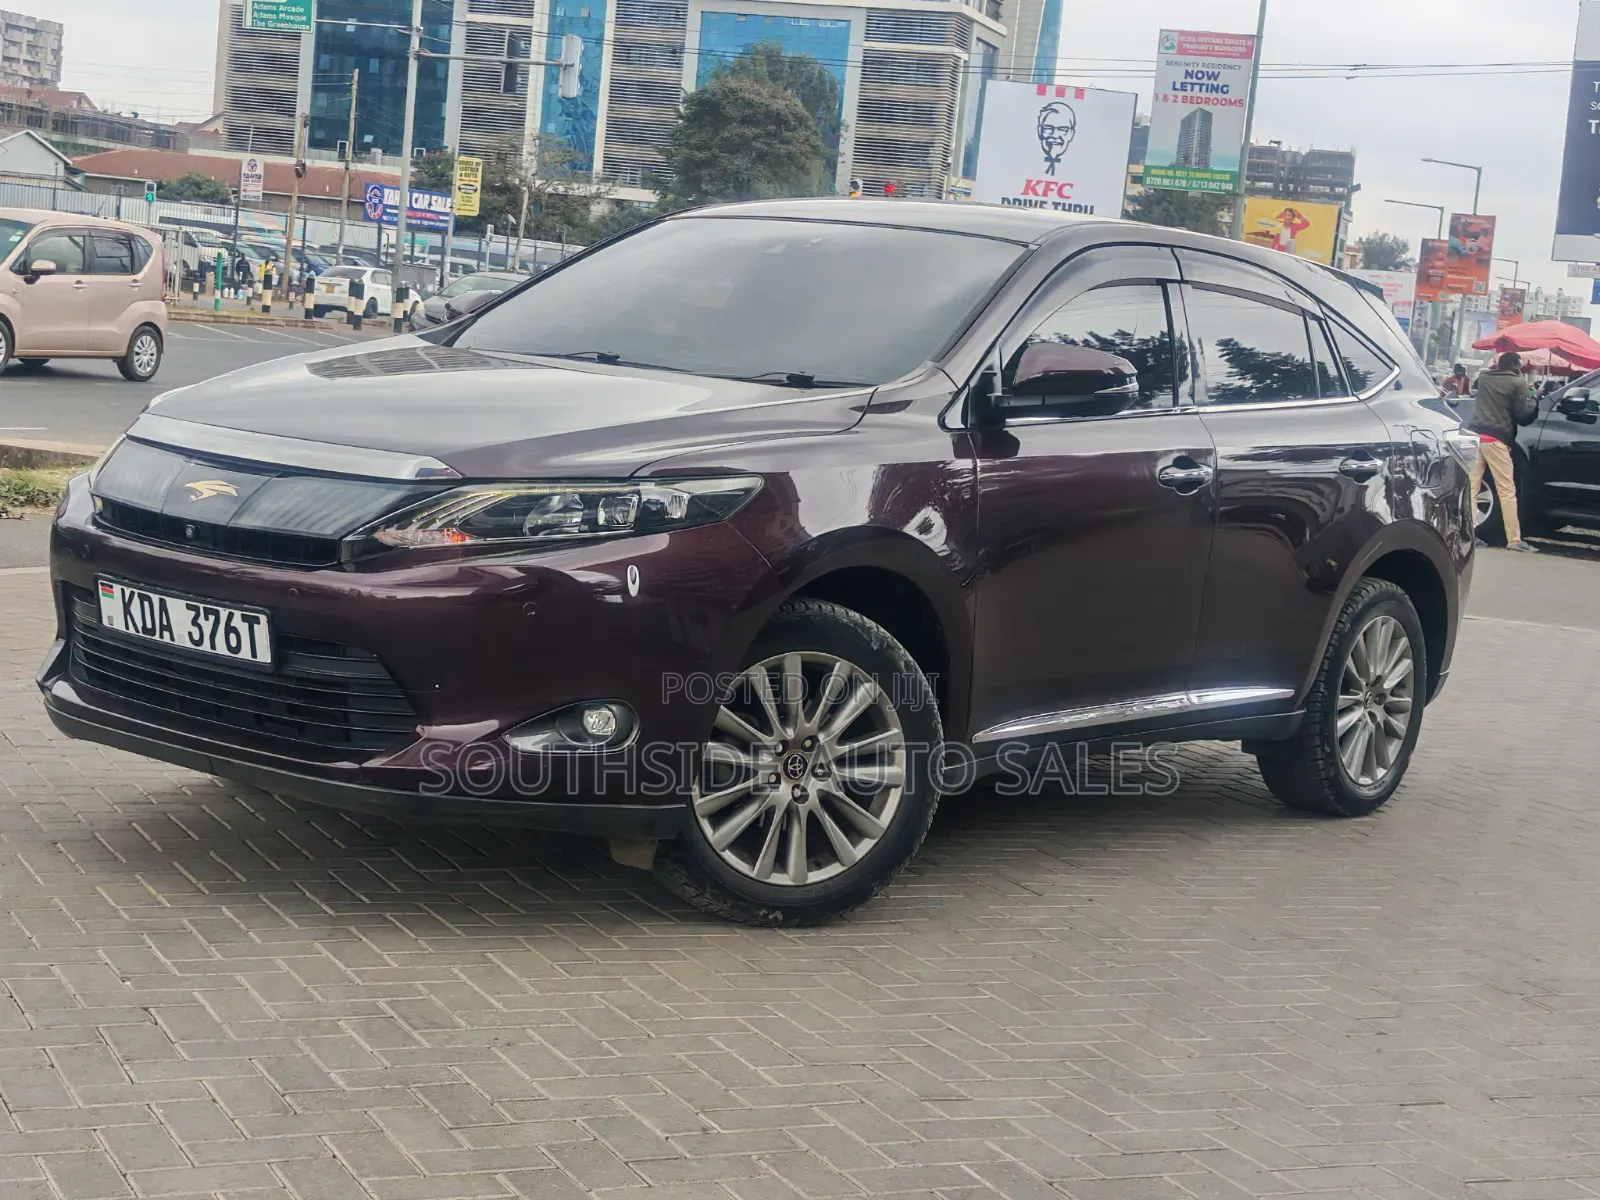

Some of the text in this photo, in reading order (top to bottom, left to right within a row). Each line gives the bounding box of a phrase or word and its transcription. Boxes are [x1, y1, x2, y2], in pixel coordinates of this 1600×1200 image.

[253, 3, 305, 13] Adams Arcade
[253, 11, 307, 21] Adams Mosque
[267, 21, 310, 30] Greenhouse
[1165, 60, 1242, 70] SERENITY RESIDENCY
[1184, 70, 1220, 81] NOW
[1172, 81, 1230, 94] LETTING
[1153, 93, 1244, 107] 1 & 2 BEDROOMS
[1020, 179, 1074, 199] KFC
[412, 192, 430, 210] CAR
[121, 588, 260, 659] KDA 376T
